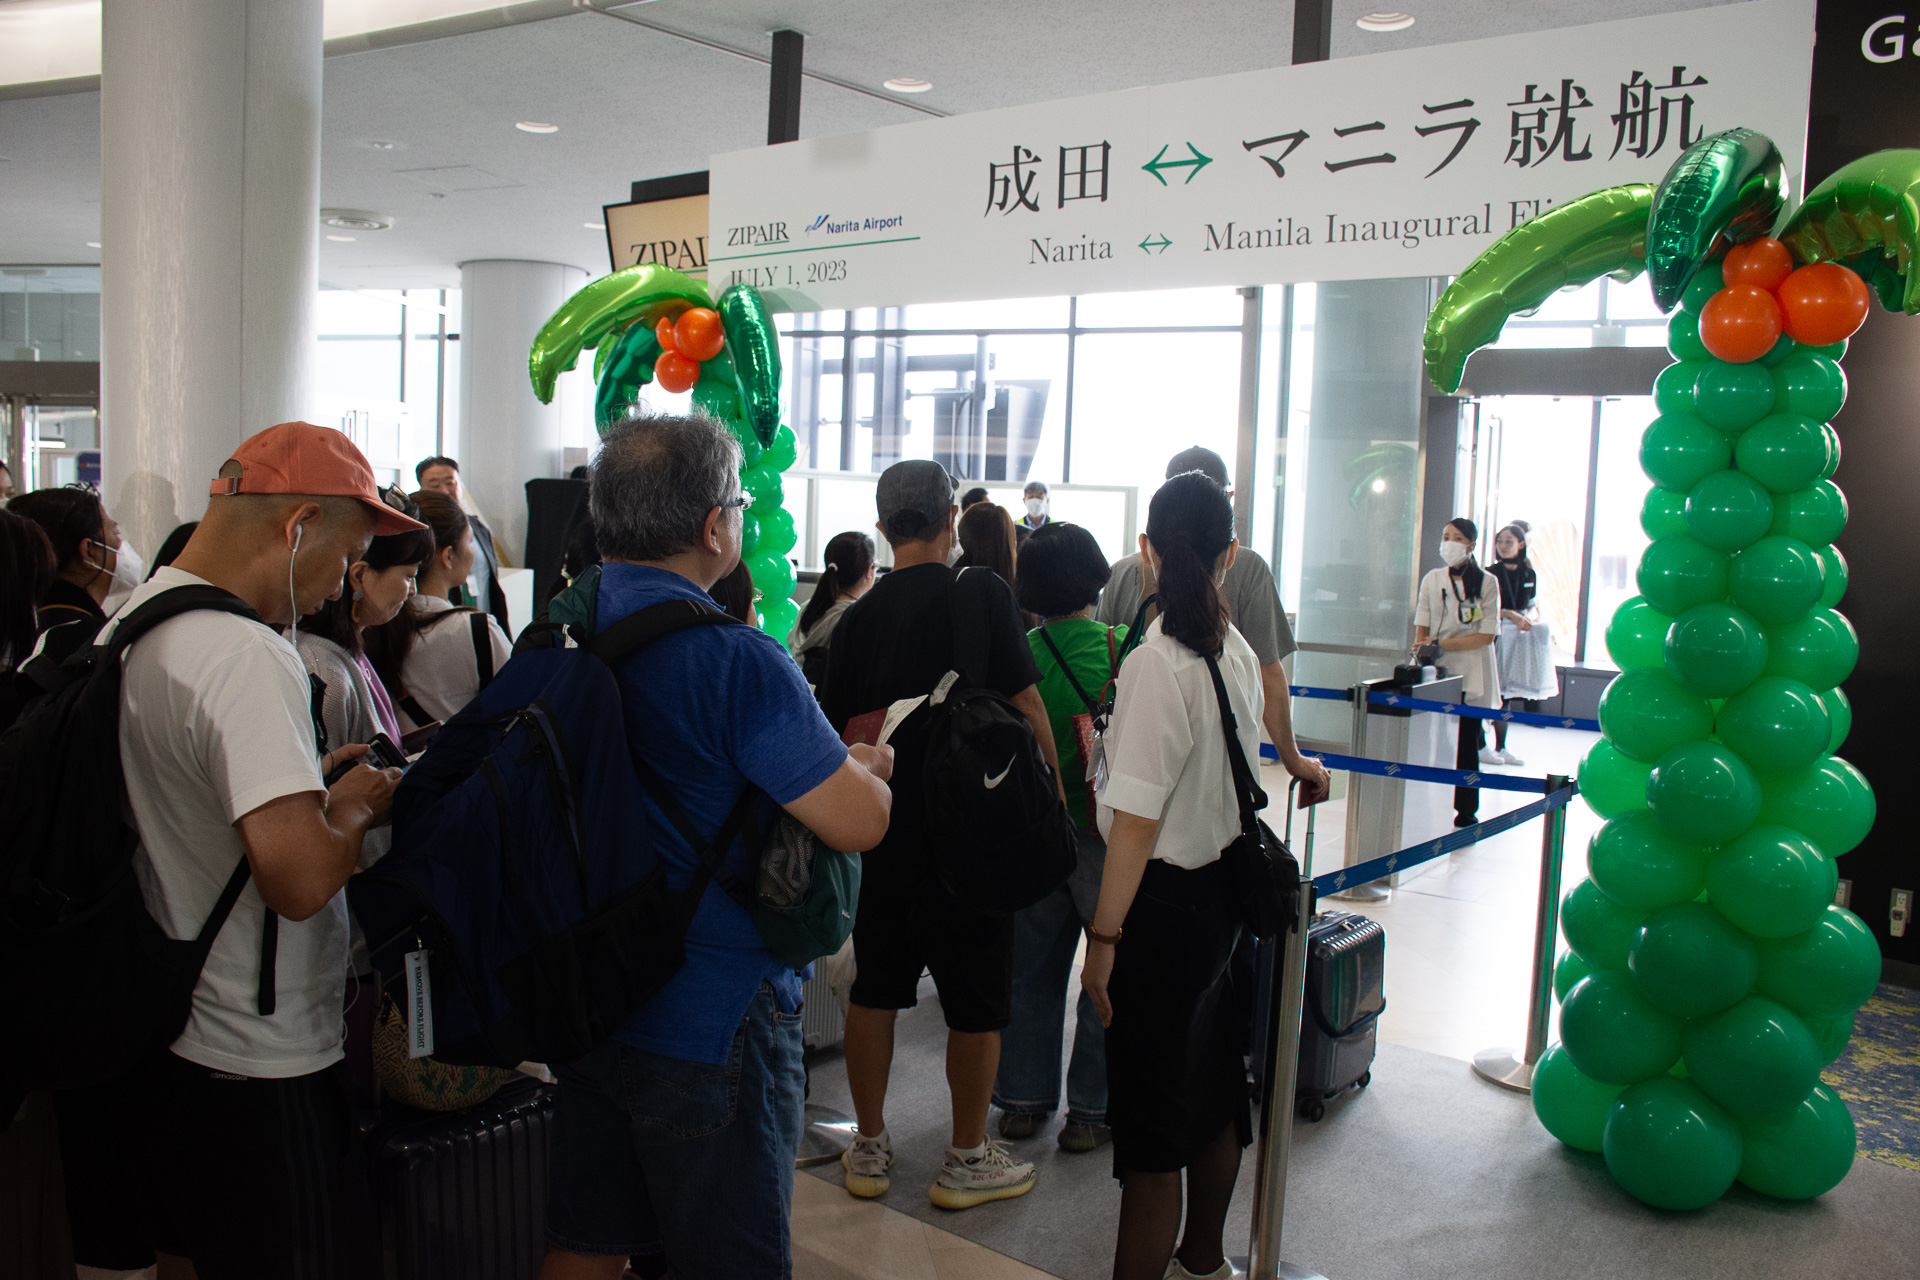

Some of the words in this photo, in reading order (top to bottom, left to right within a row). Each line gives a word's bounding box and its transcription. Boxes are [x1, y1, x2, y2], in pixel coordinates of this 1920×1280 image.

[1861, 14, 1920, 64] G
[984, 139, 1112, 218] 成田
[1242, 66, 1709, 179] マニラ就航
[727, 221, 790, 246] ZIPAIR
[826, 220, 860, 234] Narita
[863, 215, 903, 232] Airport
[1029, 234, 1113, 264] Narita
[1203, 217, 1312, 252] Manila
[1324, 203, 1492, 249] Inaugural
[630, 236, 708, 270] ZIPAI
[787, 265, 801, 290] 1,
[807, 259, 847, 283] 2023
[415, 966, 423, 996] REMOVE
[416, 996, 424, 1023] BEFORE
[417, 1023, 425, 1049] FLIGHT
